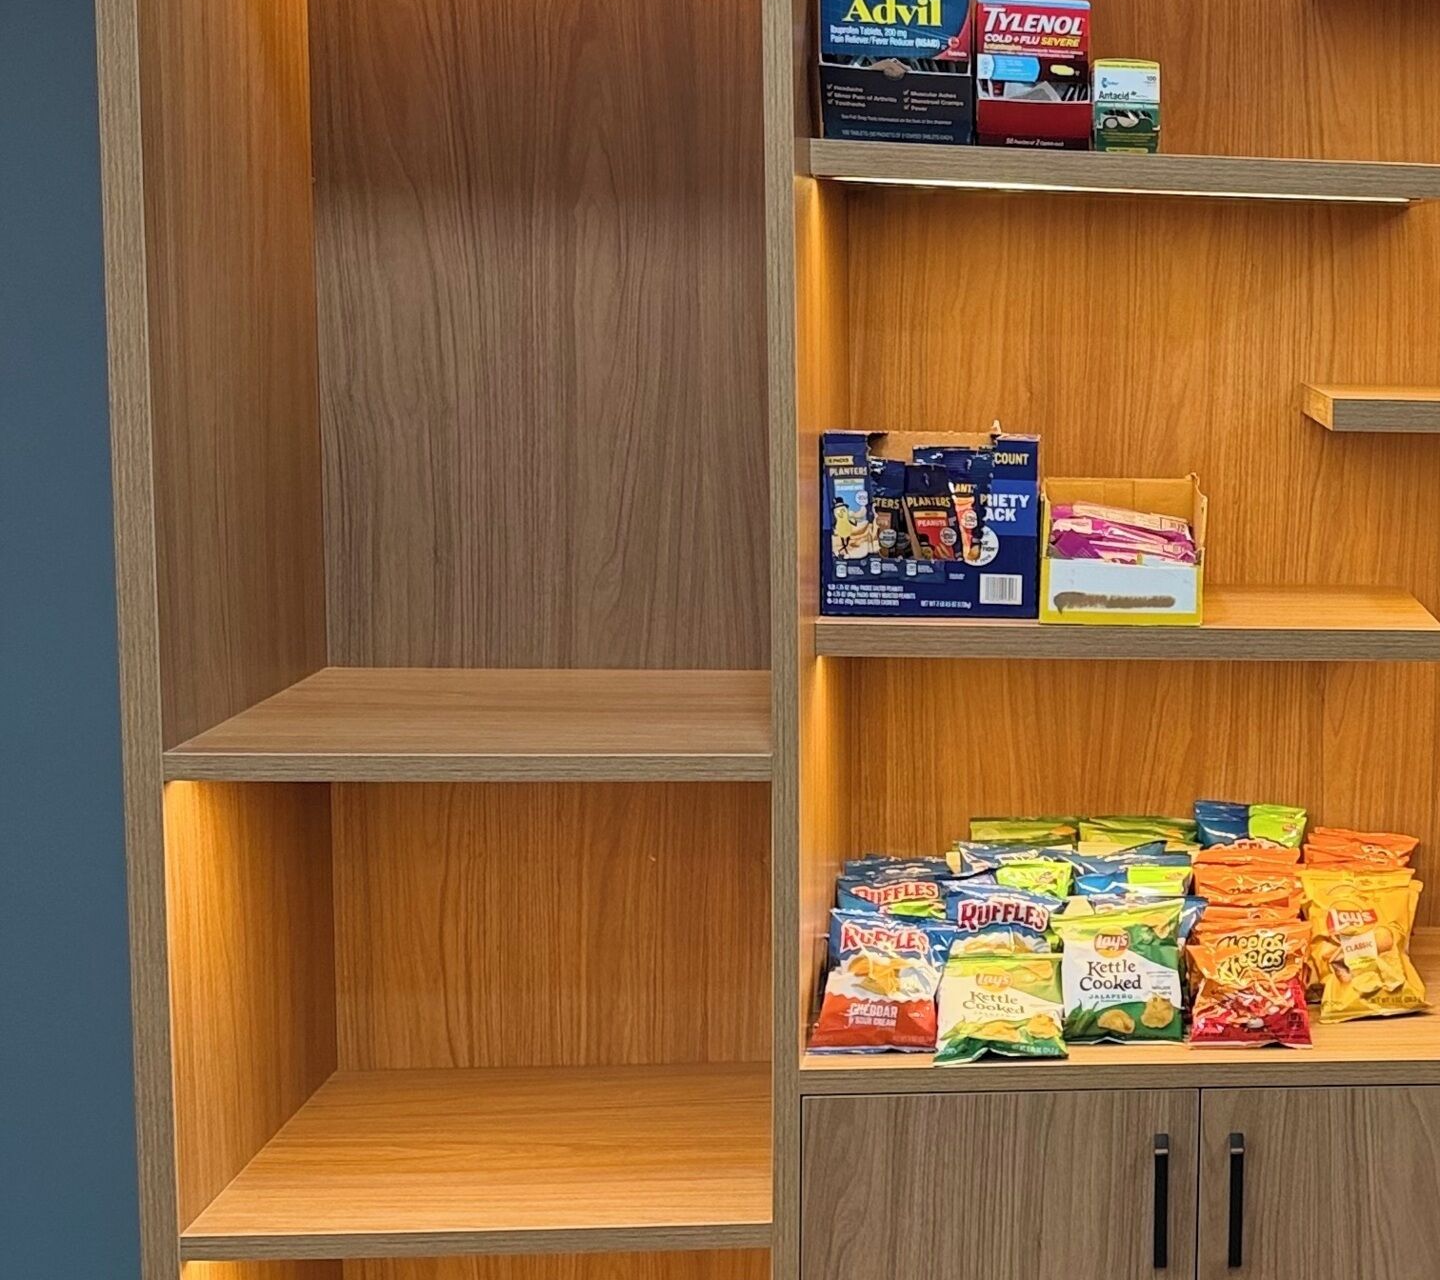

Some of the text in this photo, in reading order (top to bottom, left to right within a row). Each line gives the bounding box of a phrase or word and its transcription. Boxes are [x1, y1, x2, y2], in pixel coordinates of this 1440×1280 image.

[983, 7, 1083, 36] TYLENOL
[1041, 37, 1080, 48] SEVERE
[1099, 90, 1130, 102] Antacid
[994, 452, 1030, 466] COUNT
[829, 466, 868, 477] PLANTERS
[907, 496, 951, 508] PLANTERS
[958, 900, 1048, 931] RUFFLES
[1330, 908, 1375, 931] Lay's
[1096, 933, 1129, 950] Lay's
[1345, 940, 1373, 953] CLASSIC
[1087, 960, 1137, 978] Kettle
[1080, 975, 1142, 992] Cooked
[969, 990, 1019, 1005] Kettle
[850, 1002, 898, 1018] CHEDDAR
[962, 1001, 1025, 1015] Cooked
